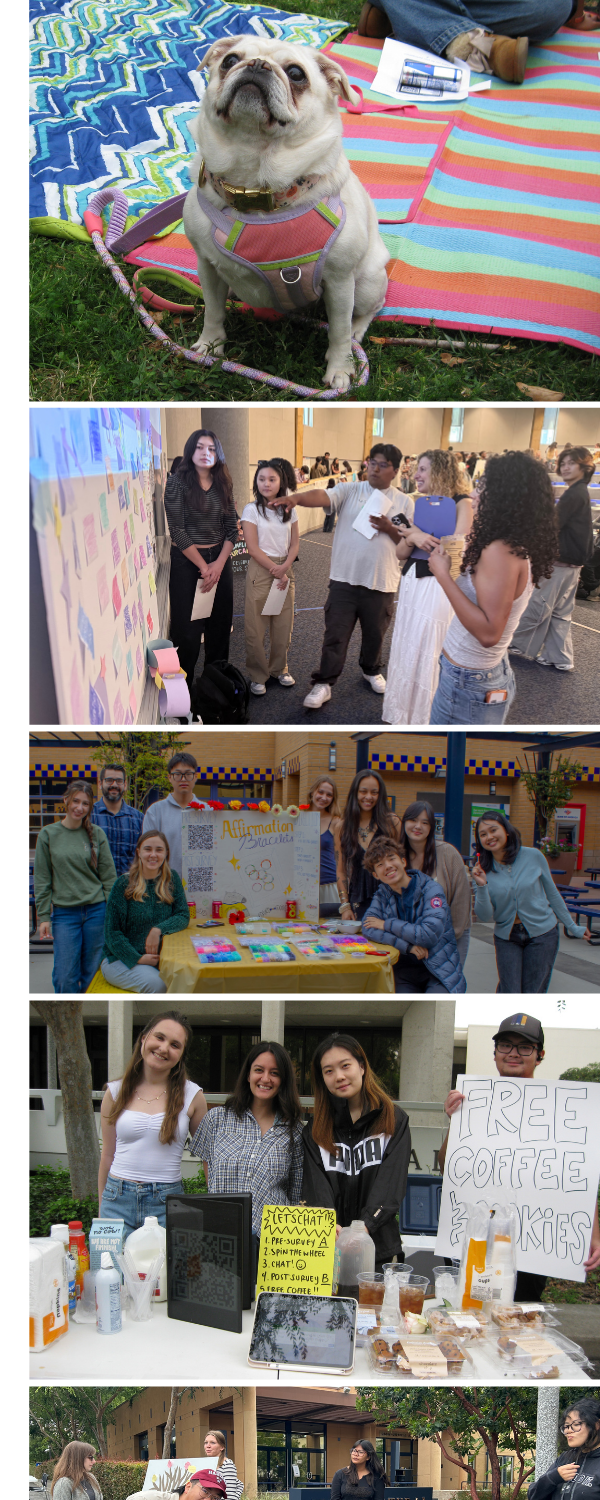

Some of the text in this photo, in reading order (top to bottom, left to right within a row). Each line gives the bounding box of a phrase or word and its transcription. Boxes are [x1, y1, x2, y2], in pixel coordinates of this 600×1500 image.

[220, 819, 294, 840] Affirmation
[459, 1079, 588, 1145] FREE
[448, 1146, 588, 1193] COFFEE
[319, 1236, 328, 1246] A
[271, 1272, 290, 1281] POST
[322, 1273, 330, 1284] B
